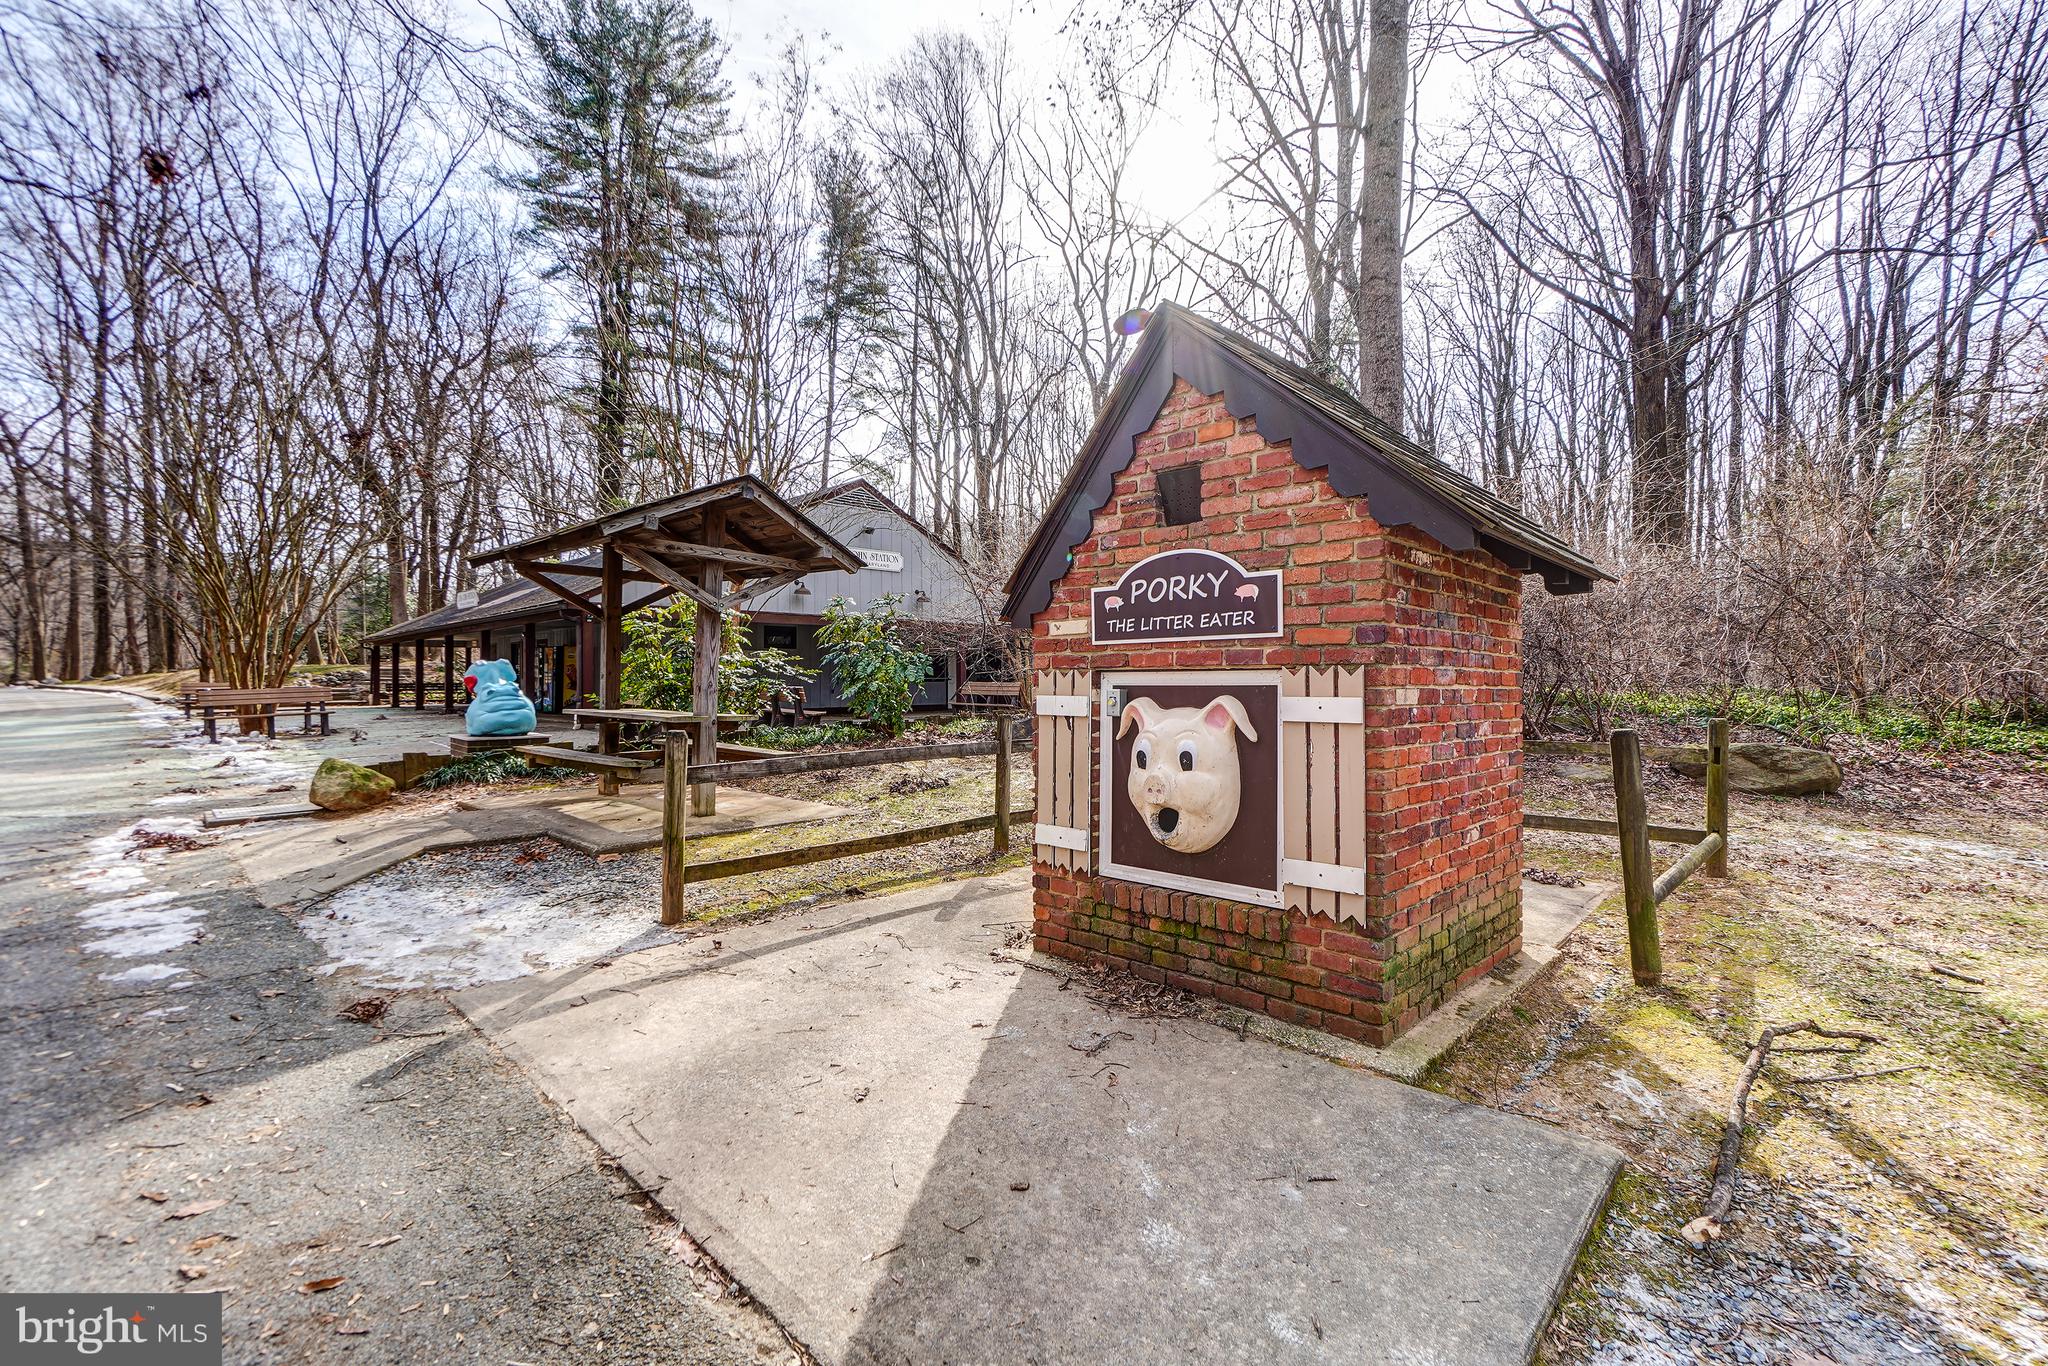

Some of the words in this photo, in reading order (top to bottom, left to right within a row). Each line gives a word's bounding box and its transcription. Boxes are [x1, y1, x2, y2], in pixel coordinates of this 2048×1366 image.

[870, 553, 899, 563] STATION
[1130, 569, 1229, 604] PORKY
[1106, 617, 1135, 633] THE
[1140, 614, 1194, 632] LITTER
[1199, 610, 1256, 629] EATER
